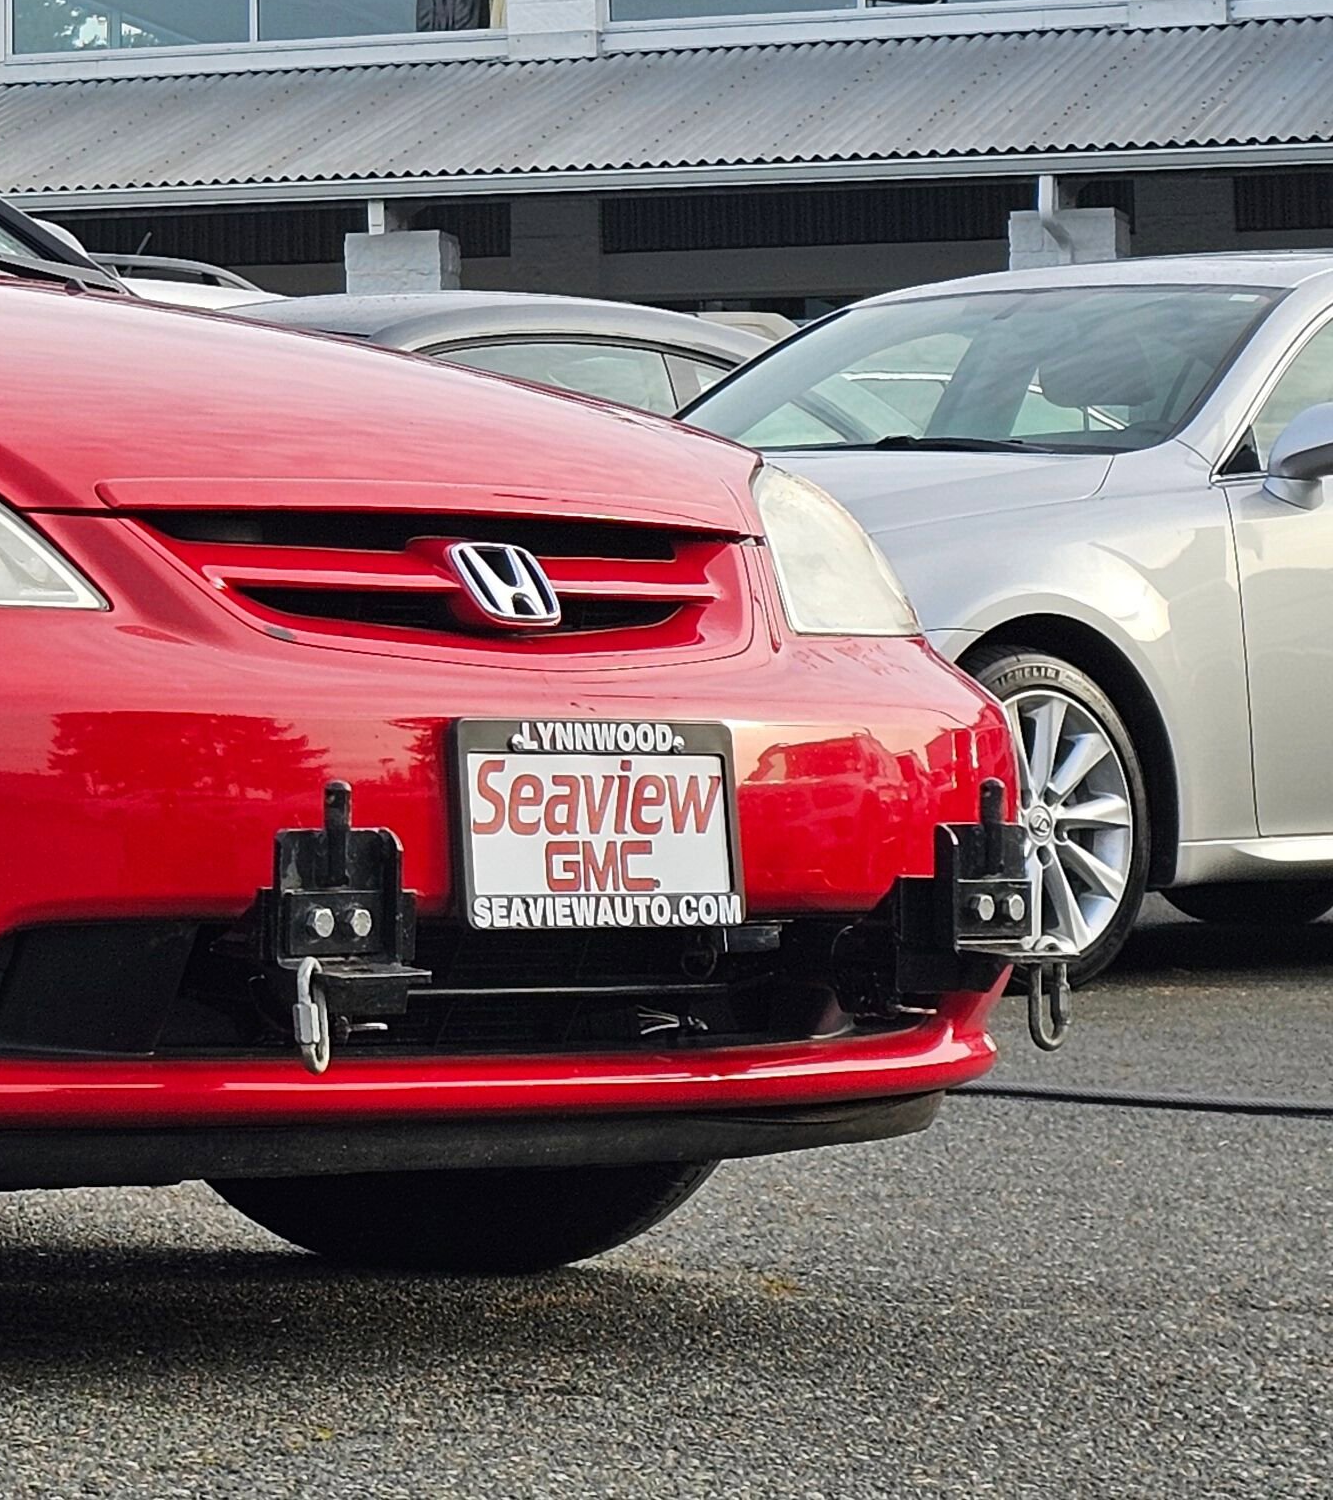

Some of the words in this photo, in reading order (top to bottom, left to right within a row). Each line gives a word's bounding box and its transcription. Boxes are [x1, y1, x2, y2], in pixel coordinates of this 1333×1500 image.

[521, 721, 674, 751] LYNNWOOD
[472, 758, 721, 836] Seaview
[544, 840, 653, 893] GMC
[472, 894, 742, 928] SEAVIEWAUTO.COM
